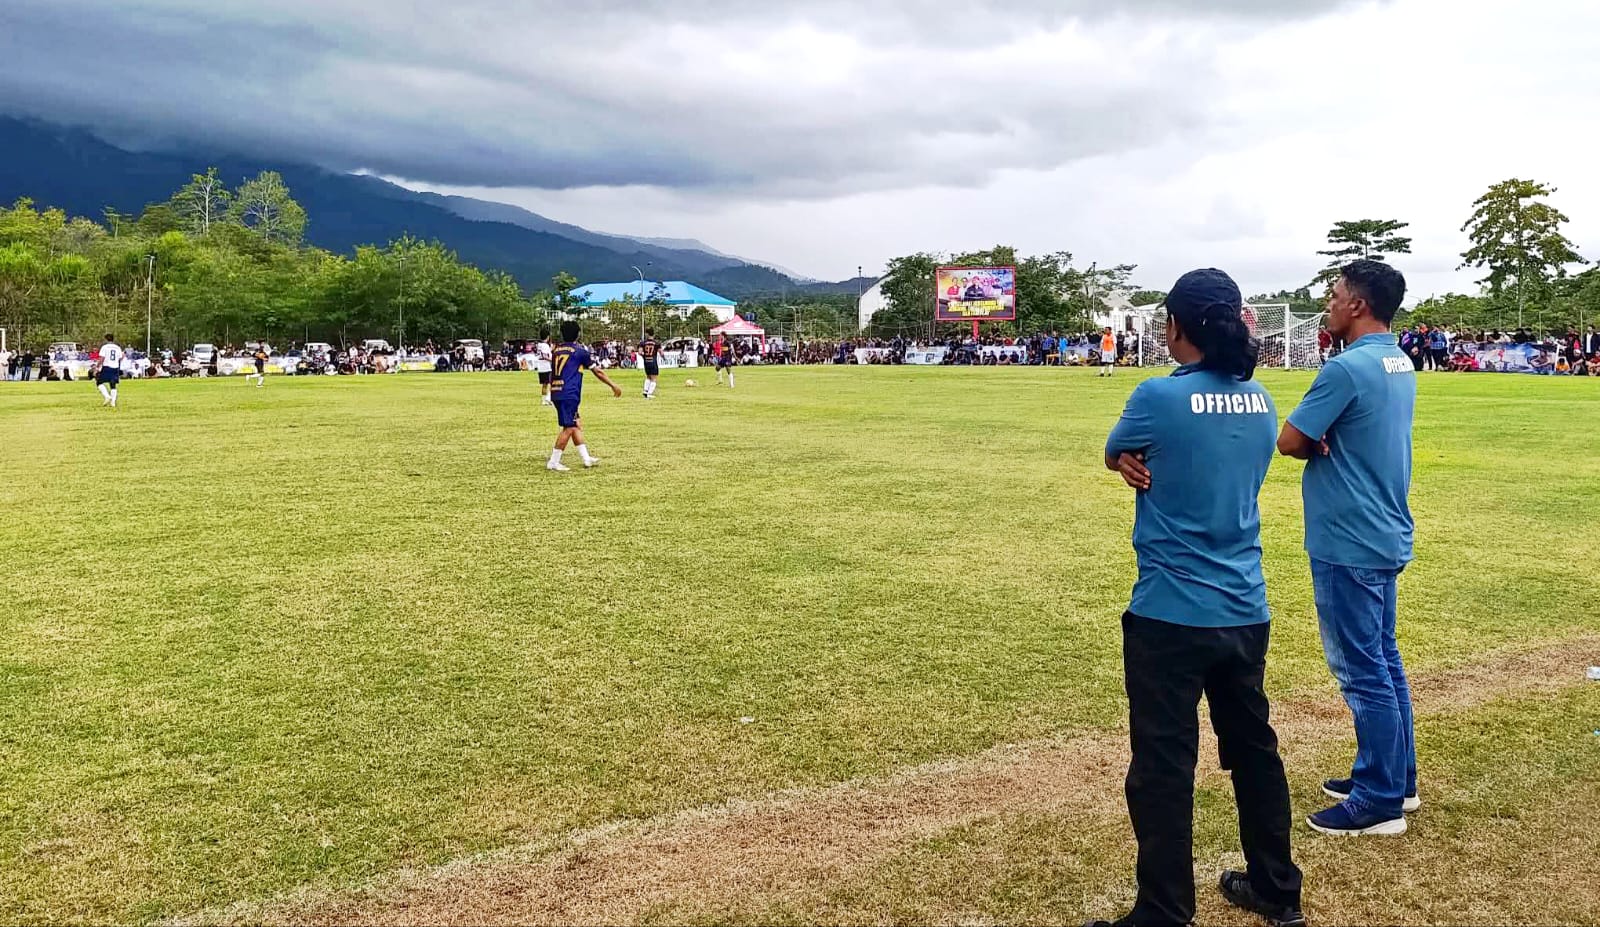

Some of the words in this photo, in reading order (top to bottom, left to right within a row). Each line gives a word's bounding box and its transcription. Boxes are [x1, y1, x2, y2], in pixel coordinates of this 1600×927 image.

[110, 349, 116, 361] 8
[554, 354, 570, 376] 17
[1382, 356, 1415, 374] OFFICIA
[1190, 392, 1269, 414] OFFICIAL
